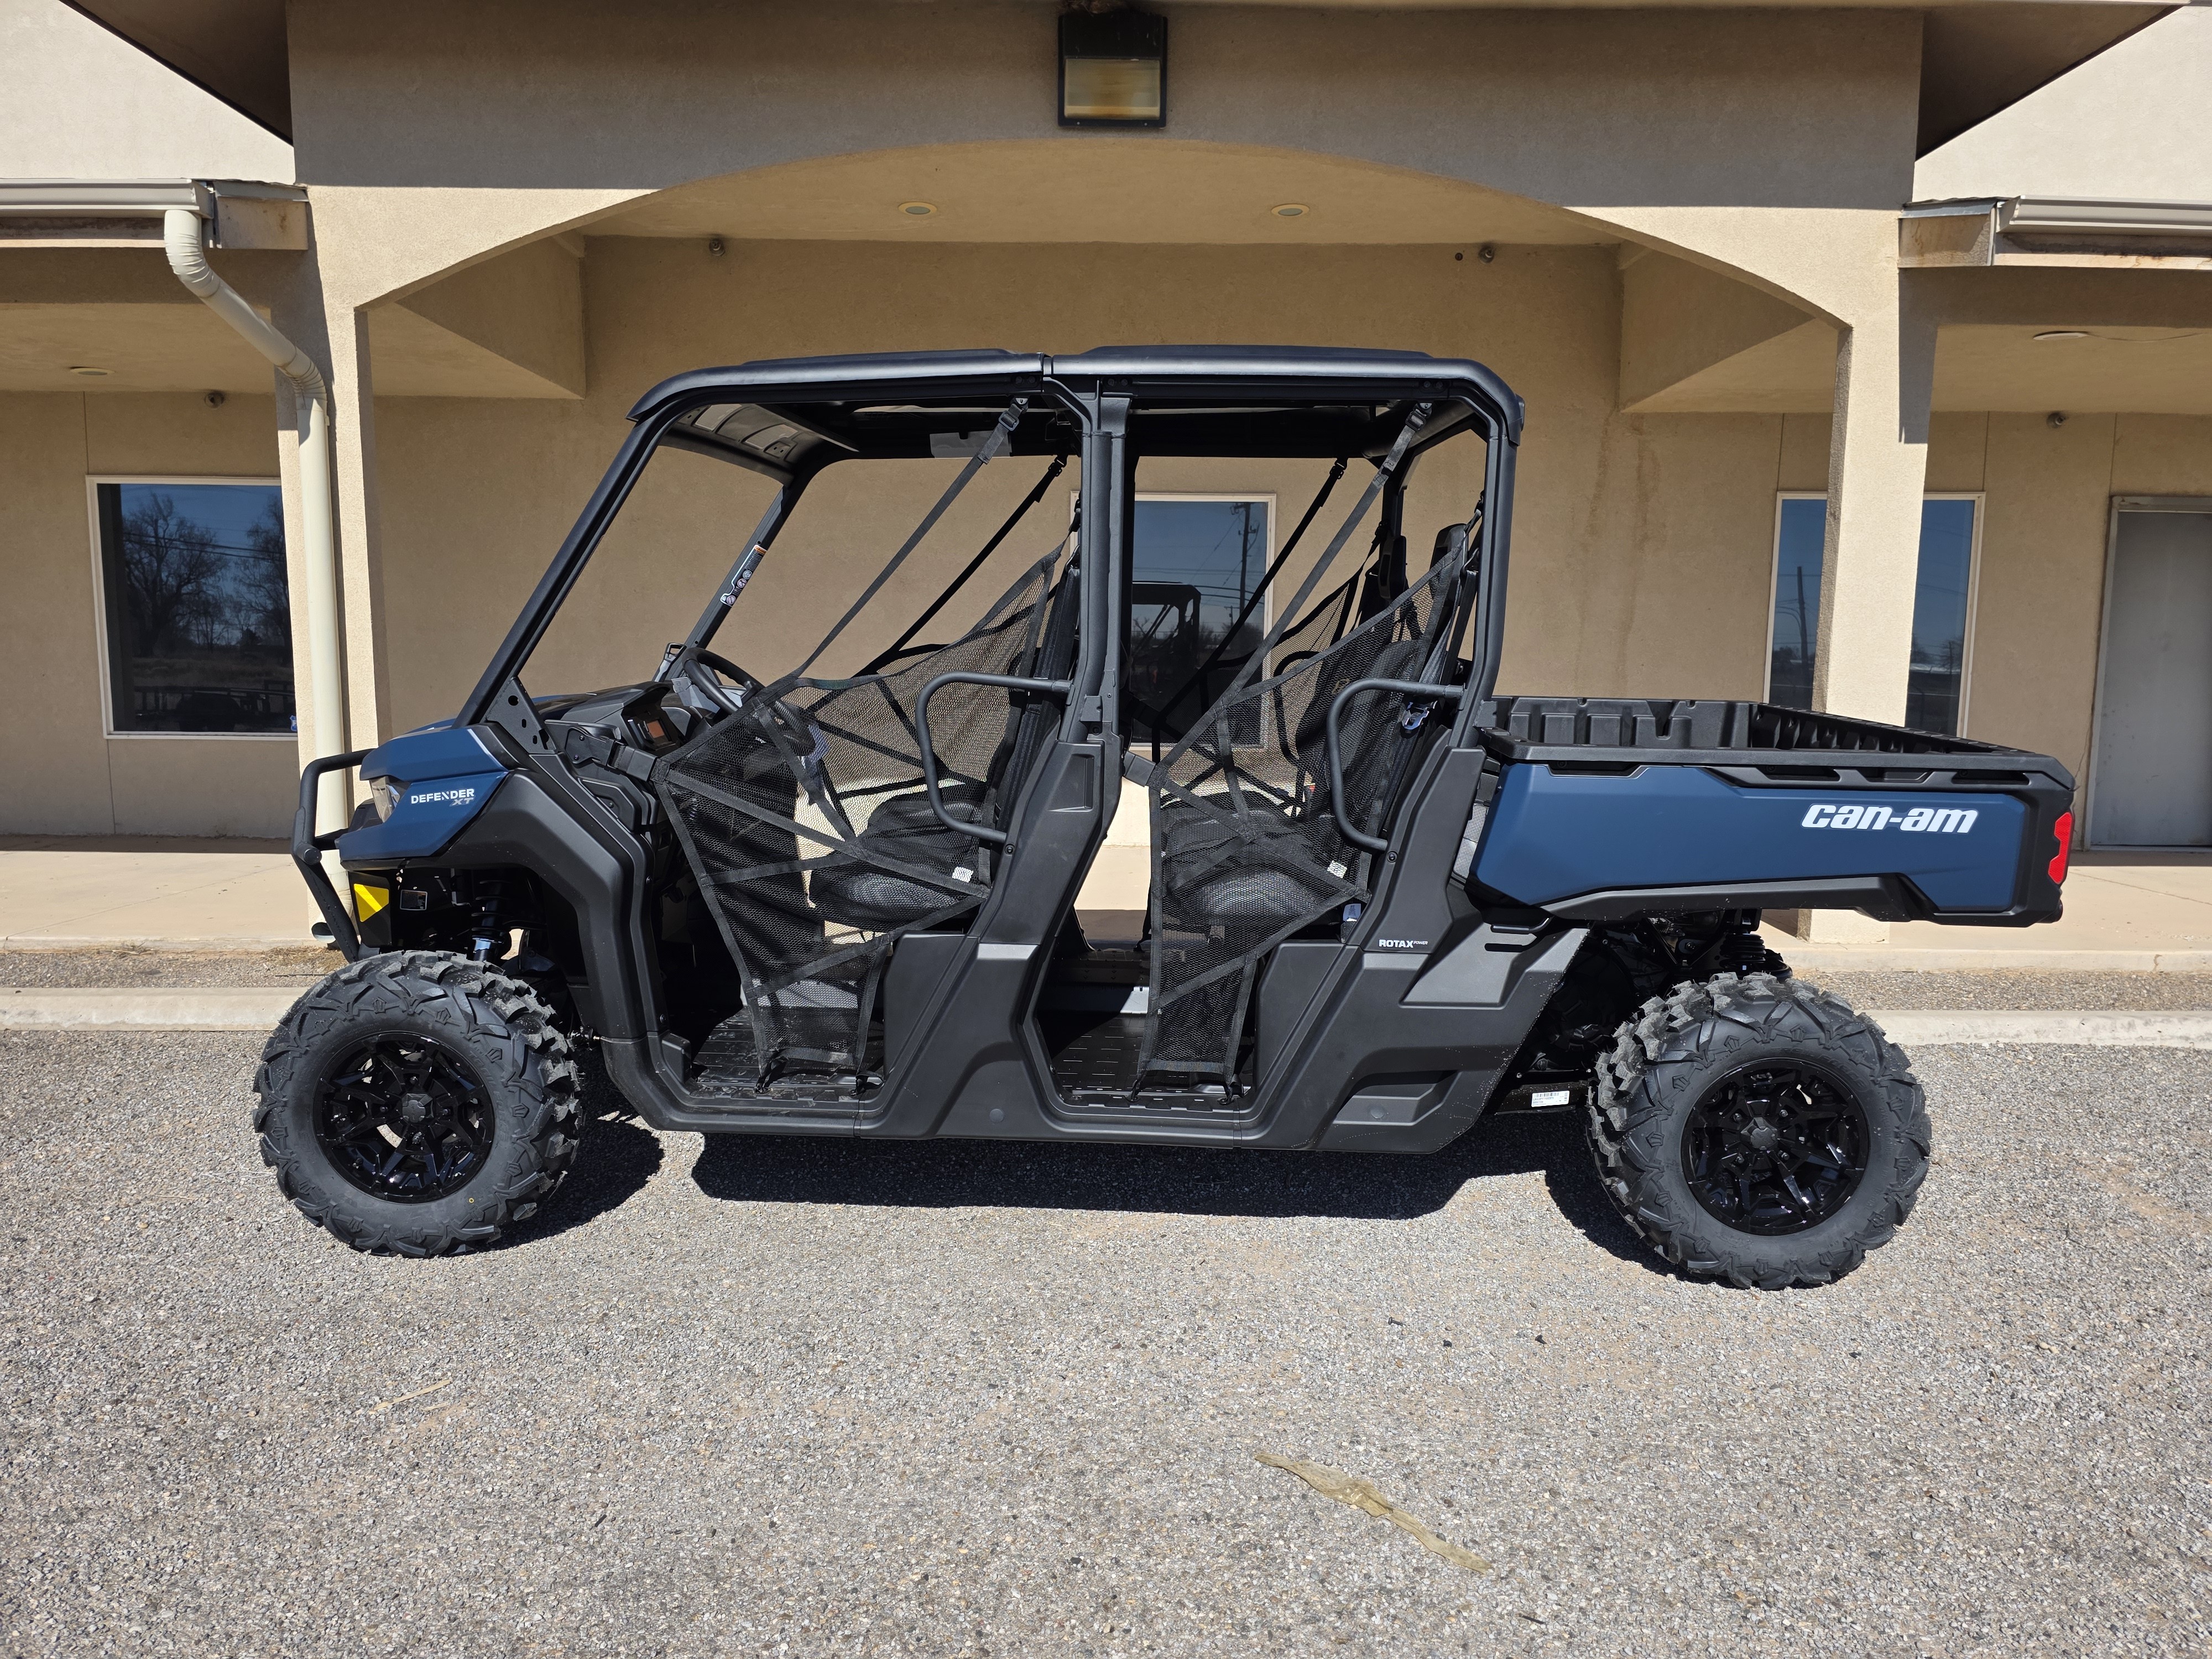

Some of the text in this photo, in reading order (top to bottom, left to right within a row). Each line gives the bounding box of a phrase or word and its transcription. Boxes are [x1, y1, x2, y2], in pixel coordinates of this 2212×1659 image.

[411, 788, 474, 804] DEFENDER
[452, 797, 474, 806] XT
[1801, 805, 1978, 833] can-am
[1379, 939, 1413, 948] ROTAX
